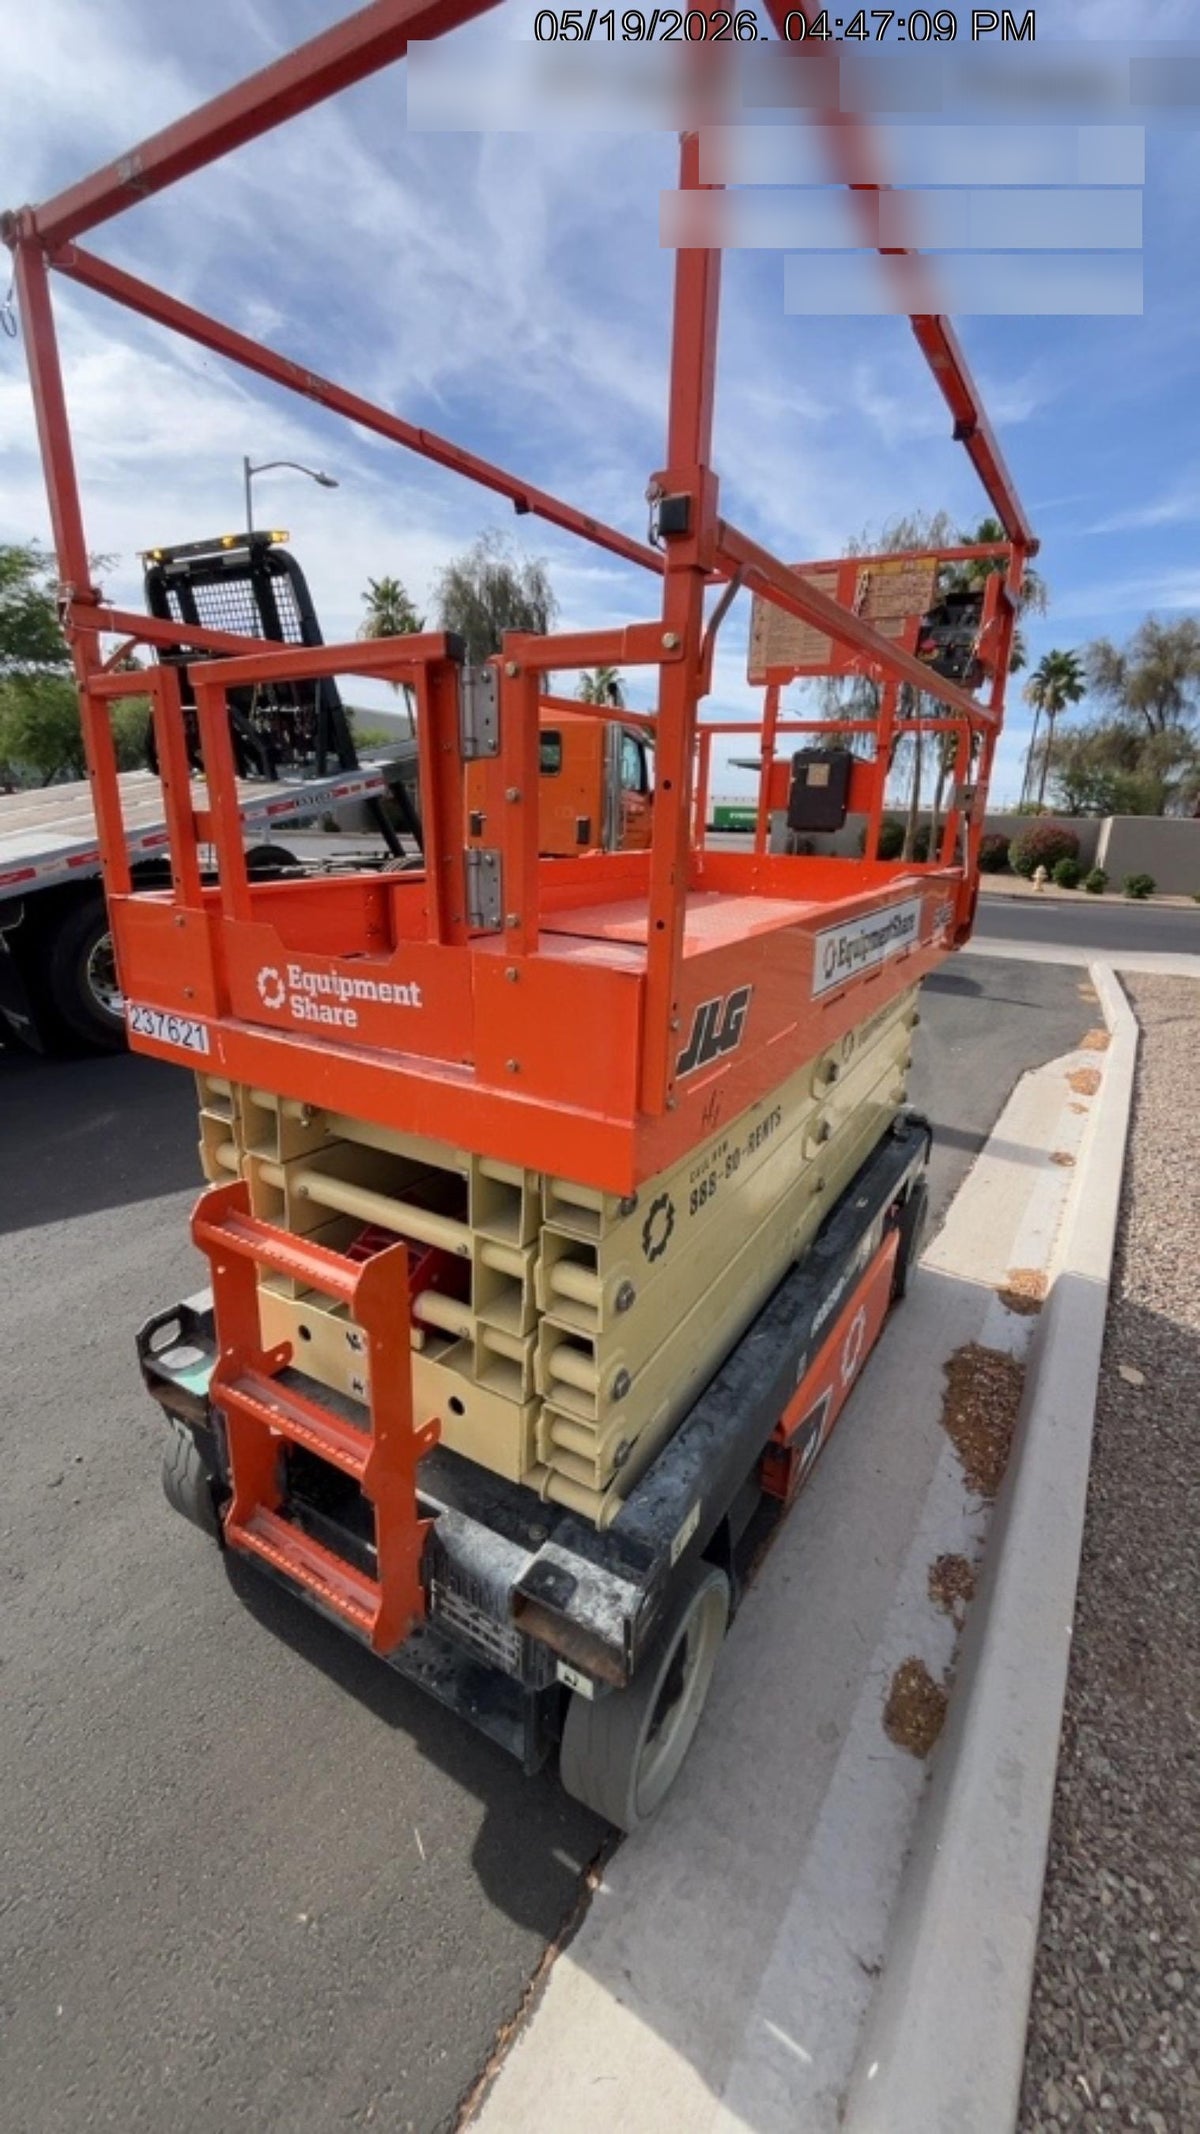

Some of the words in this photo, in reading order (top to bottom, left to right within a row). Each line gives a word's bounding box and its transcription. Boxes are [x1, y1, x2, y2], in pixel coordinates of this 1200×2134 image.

[286, 963, 423, 1008] Equipment
[131, 1006, 205, 1051] 237621
[290, 995, 358, 1028] Share
[675, 983, 754, 1081] JLG
